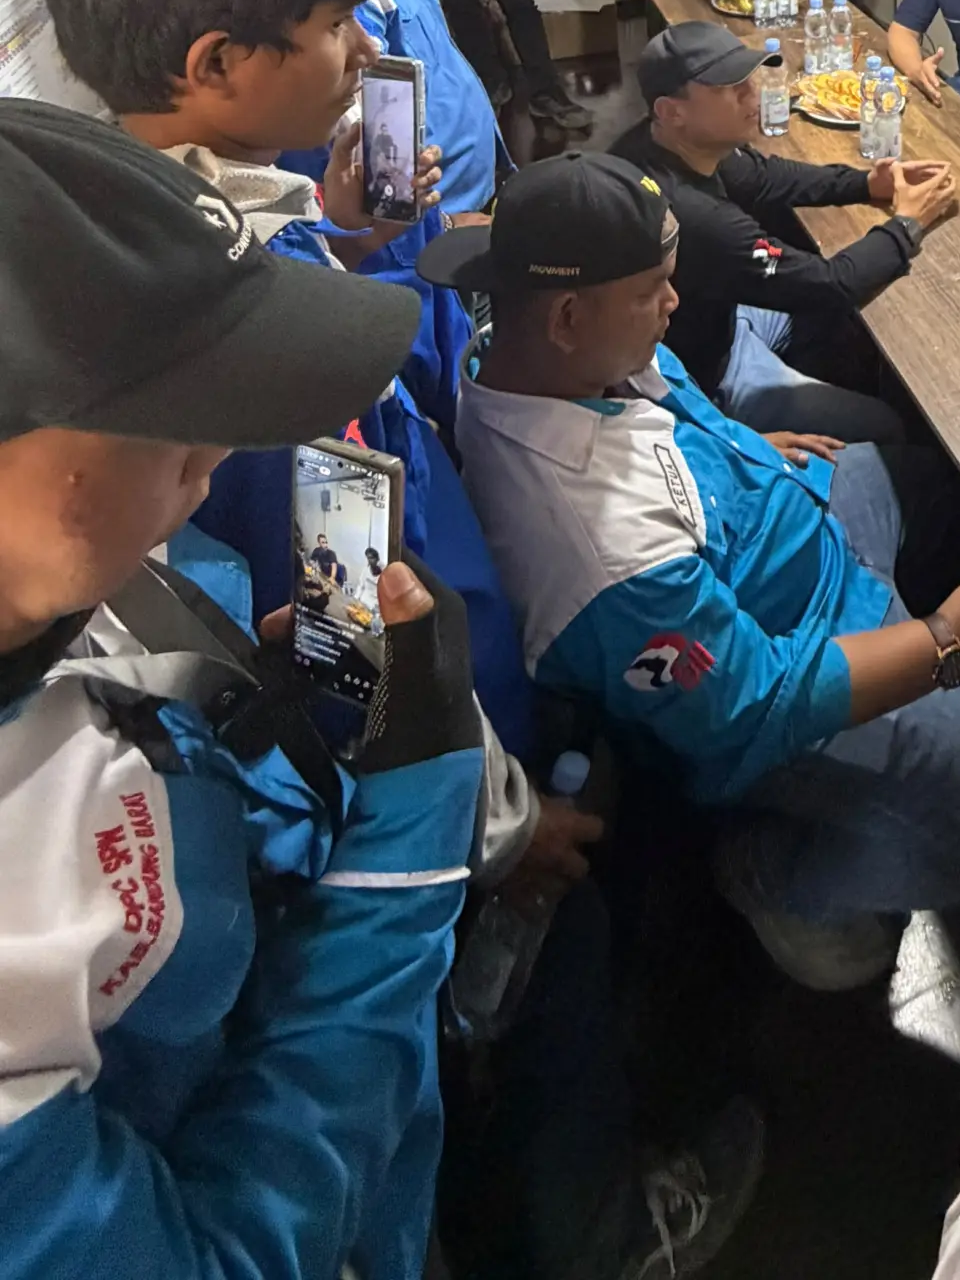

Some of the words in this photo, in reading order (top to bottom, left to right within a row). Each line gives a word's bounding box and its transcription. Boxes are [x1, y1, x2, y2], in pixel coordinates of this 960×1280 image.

[664, 462, 688, 508] KETUA
[119, 791, 155, 838] BARAT
[94, 824, 133, 875] SPN
[111, 876, 145, 934] DPC
[138, 844, 165, 936] BANDUNG
